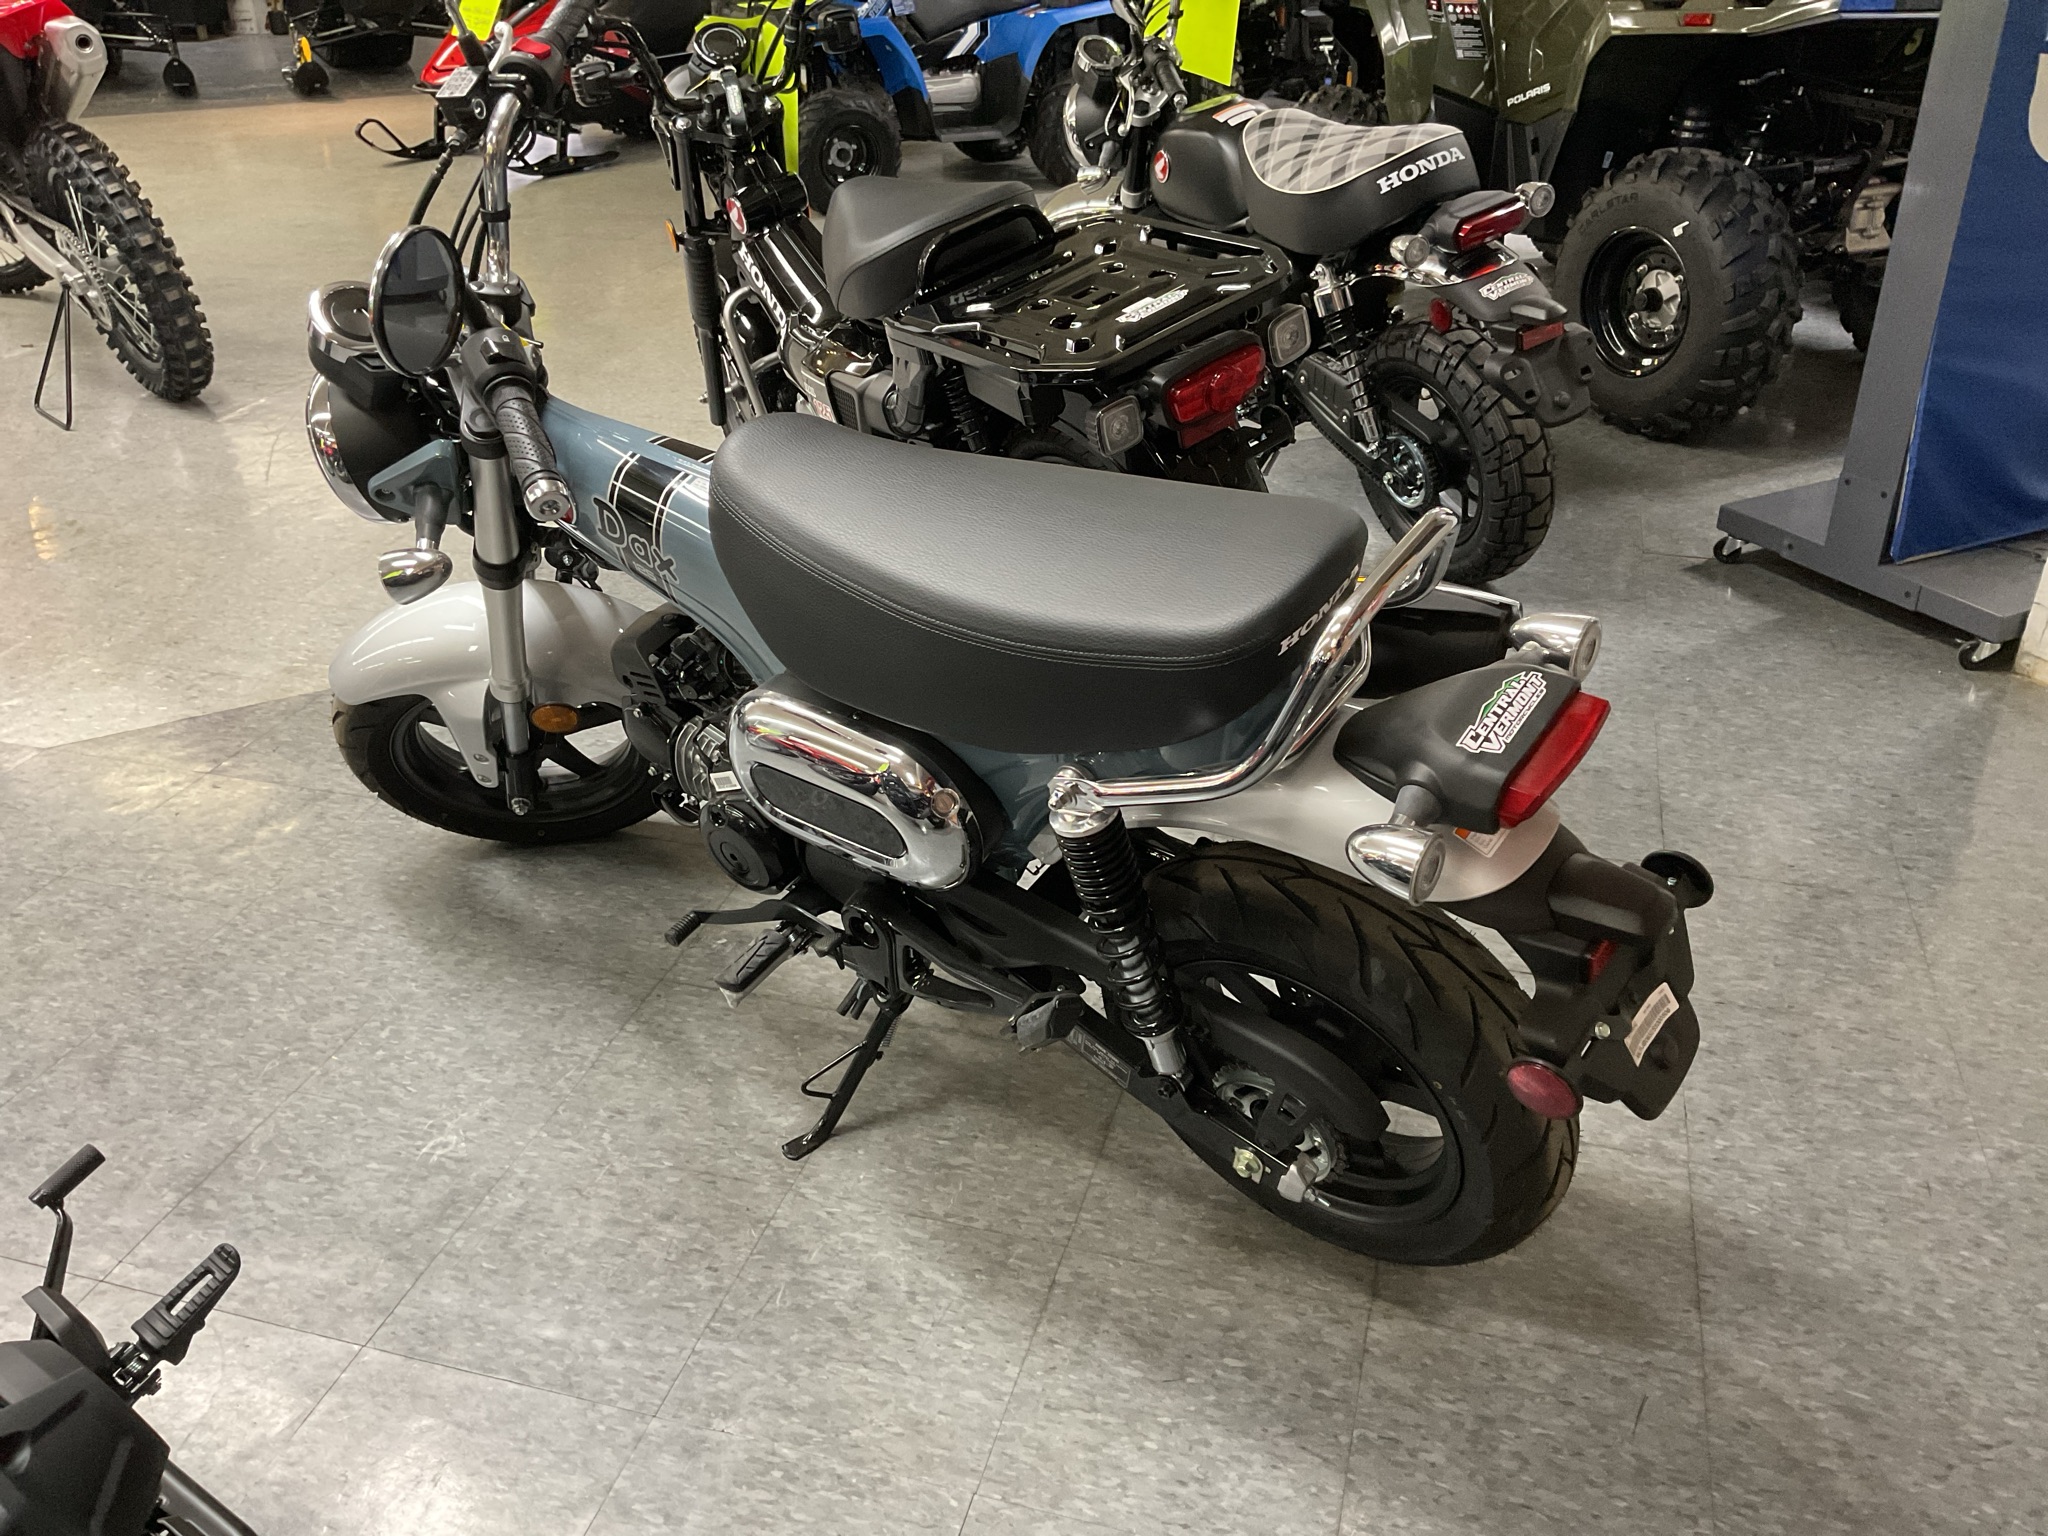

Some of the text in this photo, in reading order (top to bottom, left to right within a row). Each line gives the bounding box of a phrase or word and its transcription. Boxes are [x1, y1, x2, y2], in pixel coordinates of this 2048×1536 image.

[1506, 82, 1551, 108] POLARIS
[1376, 146, 1466, 195] HONDA
[590, 494, 680, 585] Dax
[1460, 677, 1527, 751] CENTRAL
[1480, 673, 1544, 751] VERMONT
[1504, 688, 1546, 742] MOTORCYCLES
